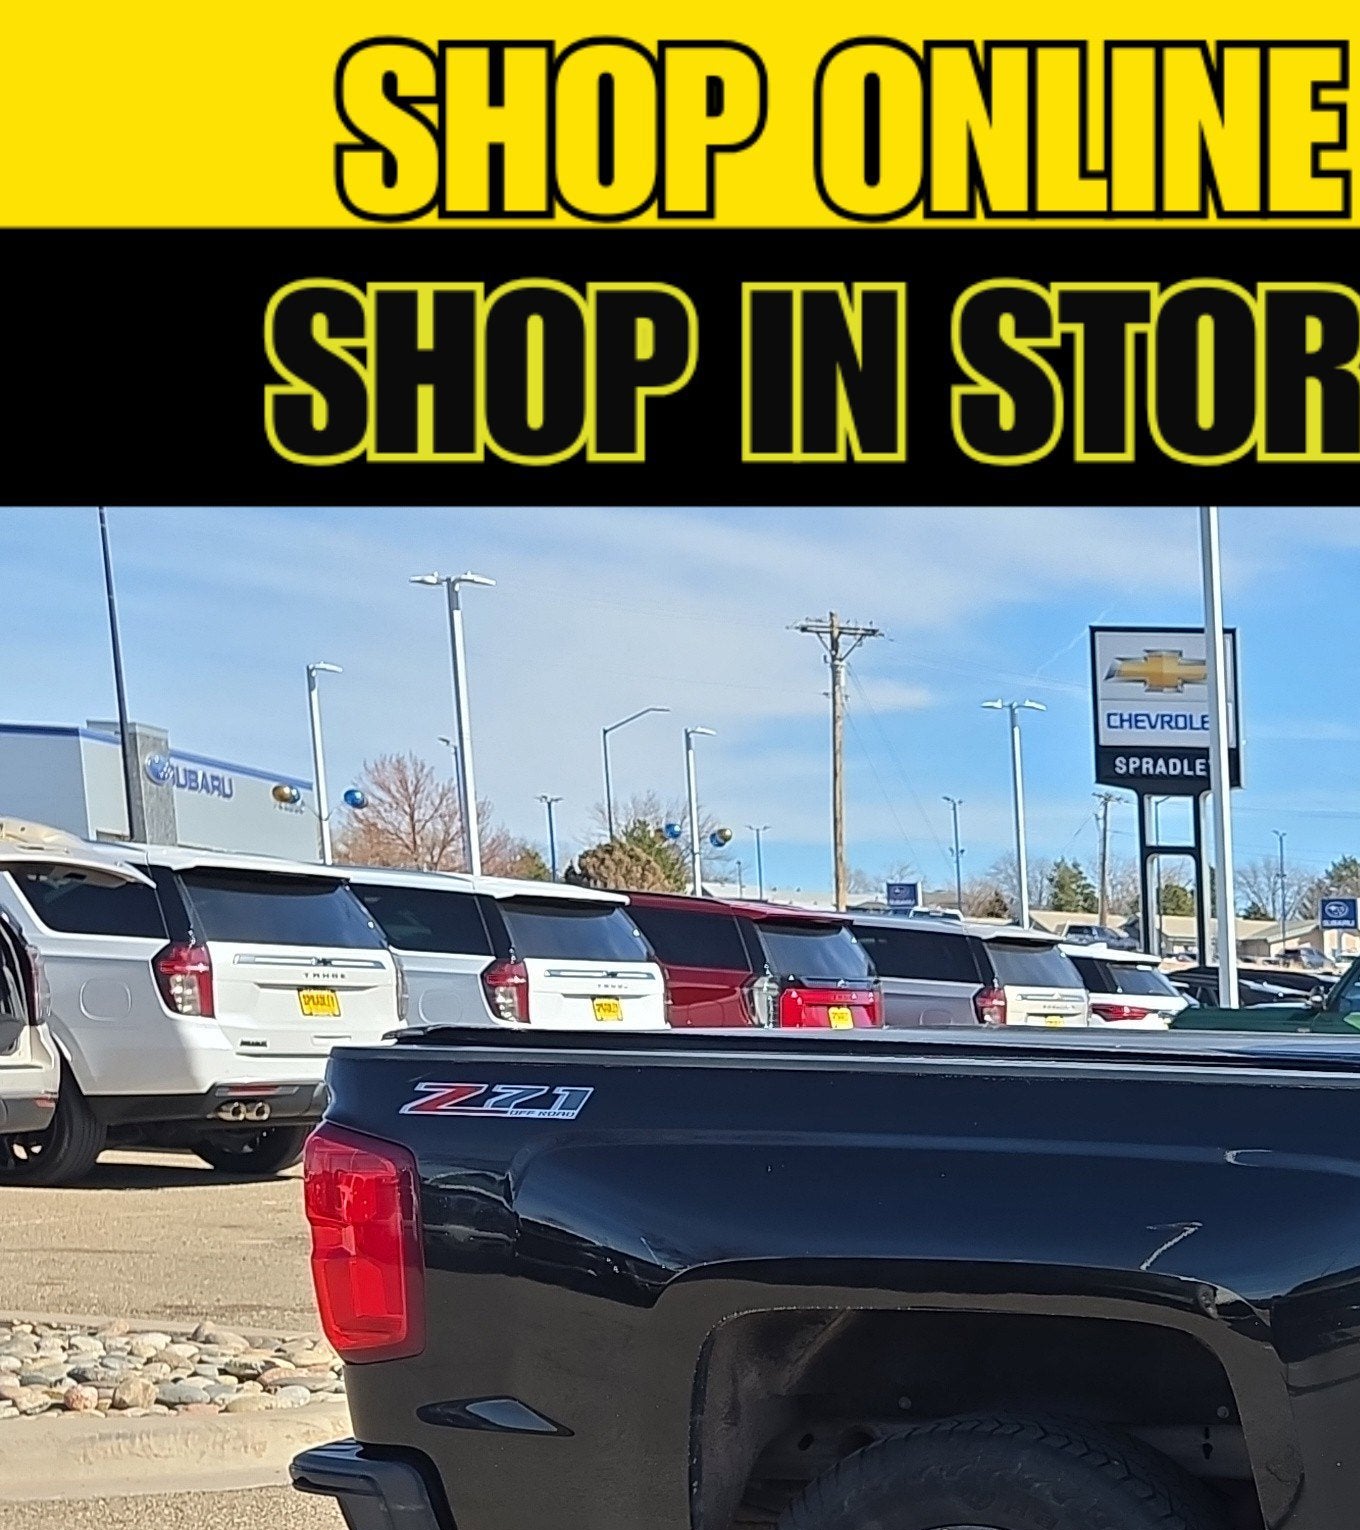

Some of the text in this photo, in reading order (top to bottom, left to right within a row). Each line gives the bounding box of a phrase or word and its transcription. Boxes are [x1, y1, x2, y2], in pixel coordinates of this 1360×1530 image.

[1107, 712, 1210, 730] CHEVROLE
[1114, 756, 1211, 776] SPRADLE
[399, 1082, 594, 1119] Z71
